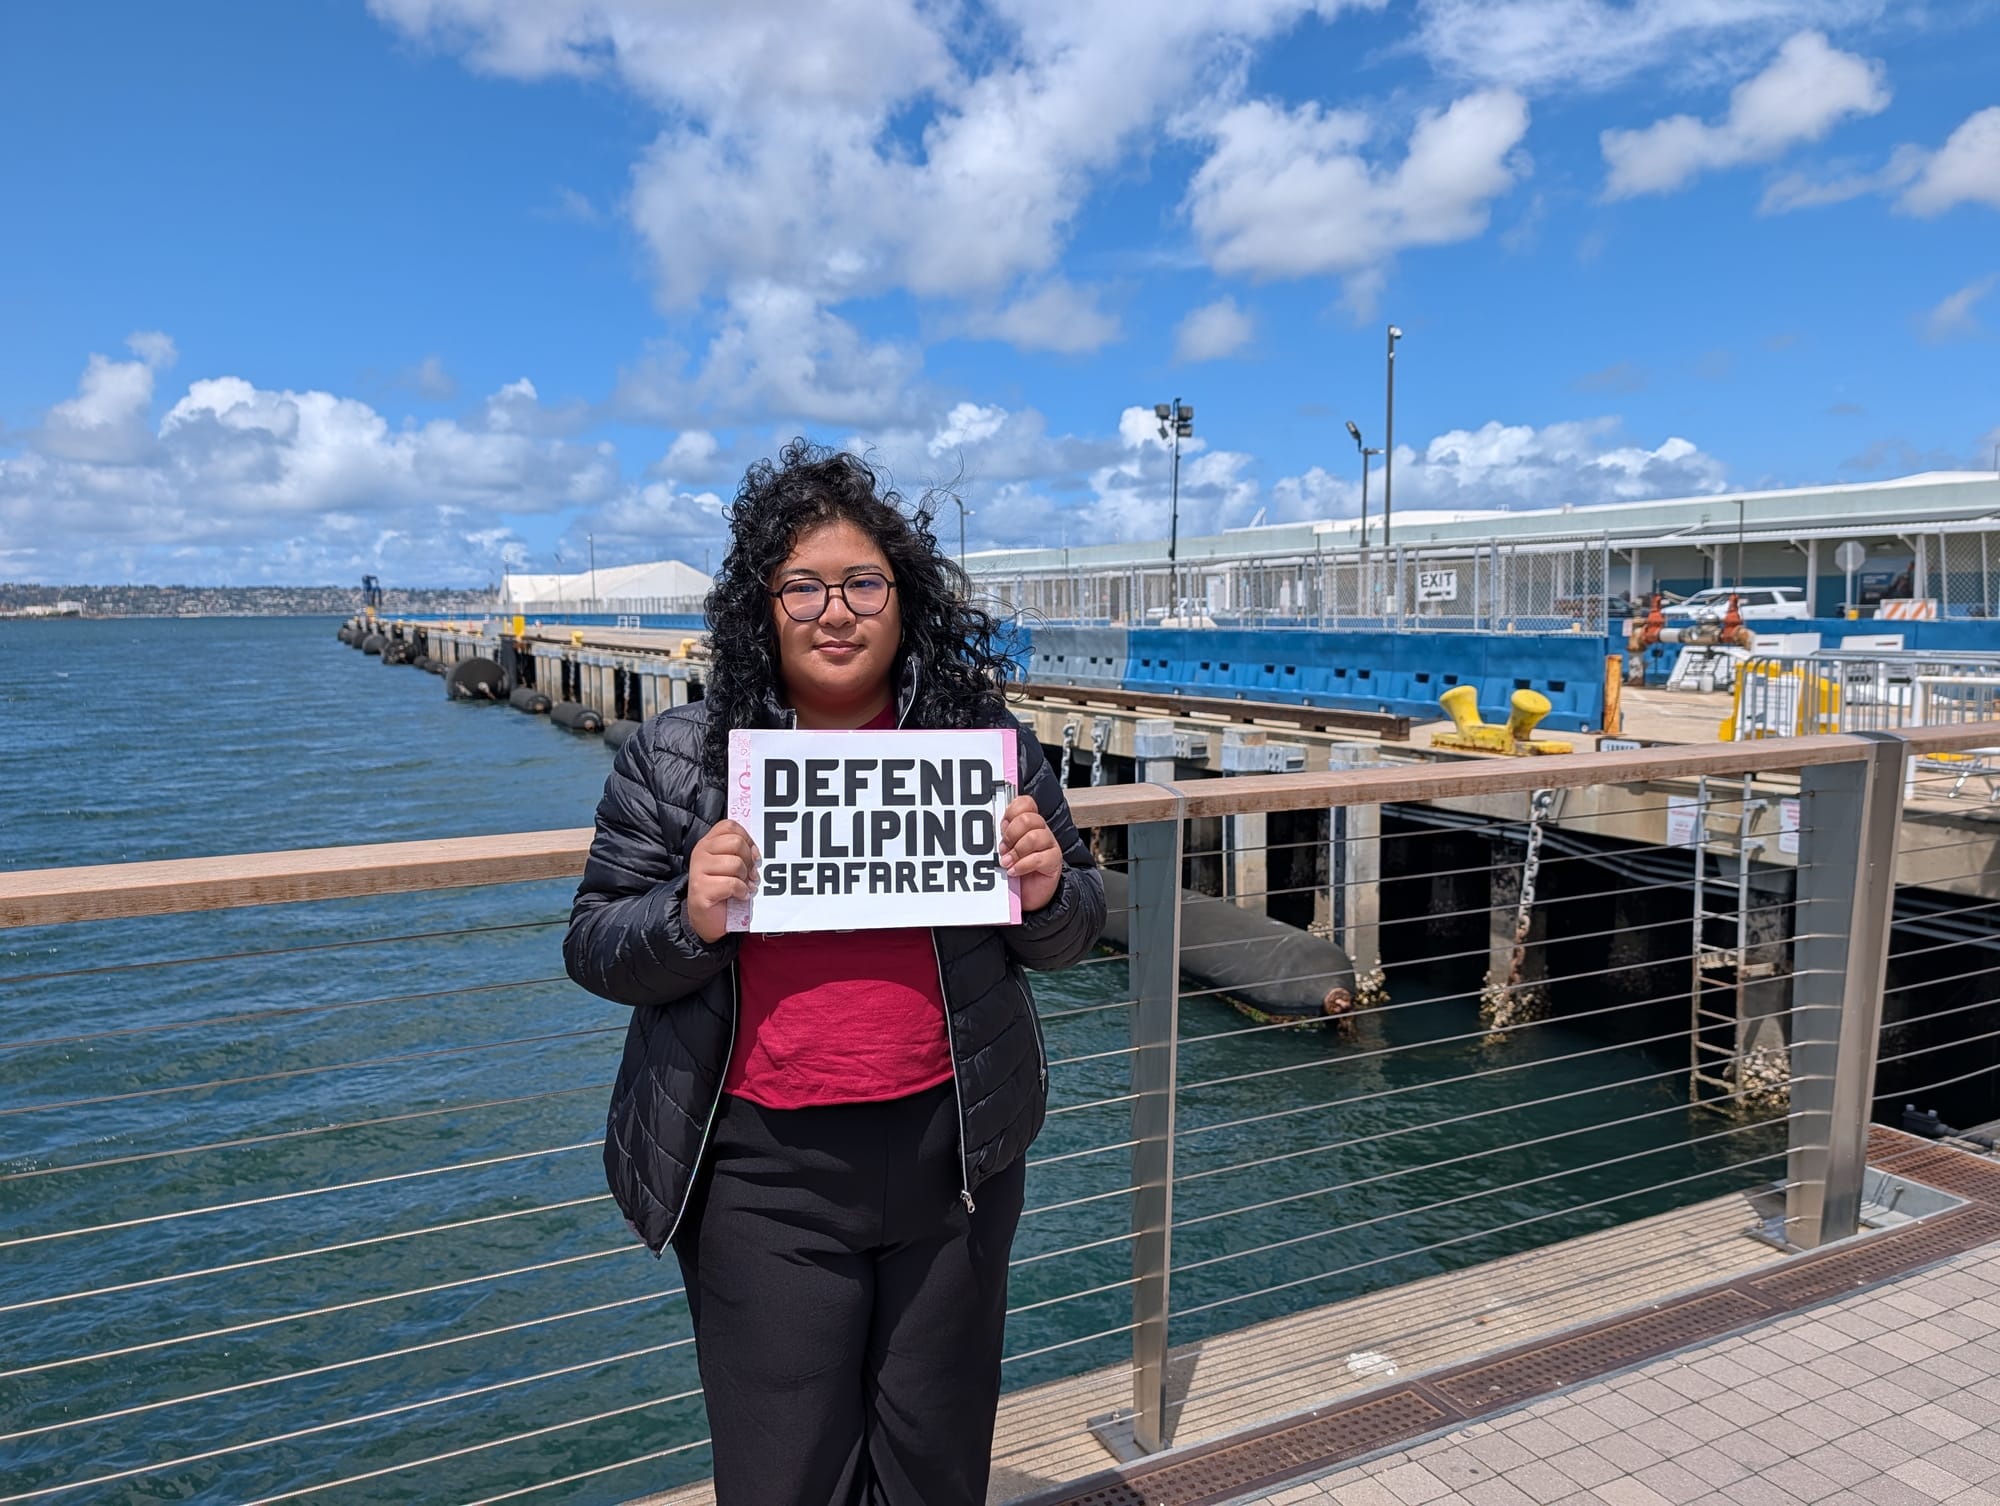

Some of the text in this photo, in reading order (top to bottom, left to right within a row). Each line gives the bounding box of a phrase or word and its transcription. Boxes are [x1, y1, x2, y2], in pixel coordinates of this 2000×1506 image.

[1420, 572, 1454, 588] EXIT
[763, 758, 993, 808] DEFEND
[763, 809, 996, 859] FILIPINO
[763, 860, 996, 896] SEAFARERS
